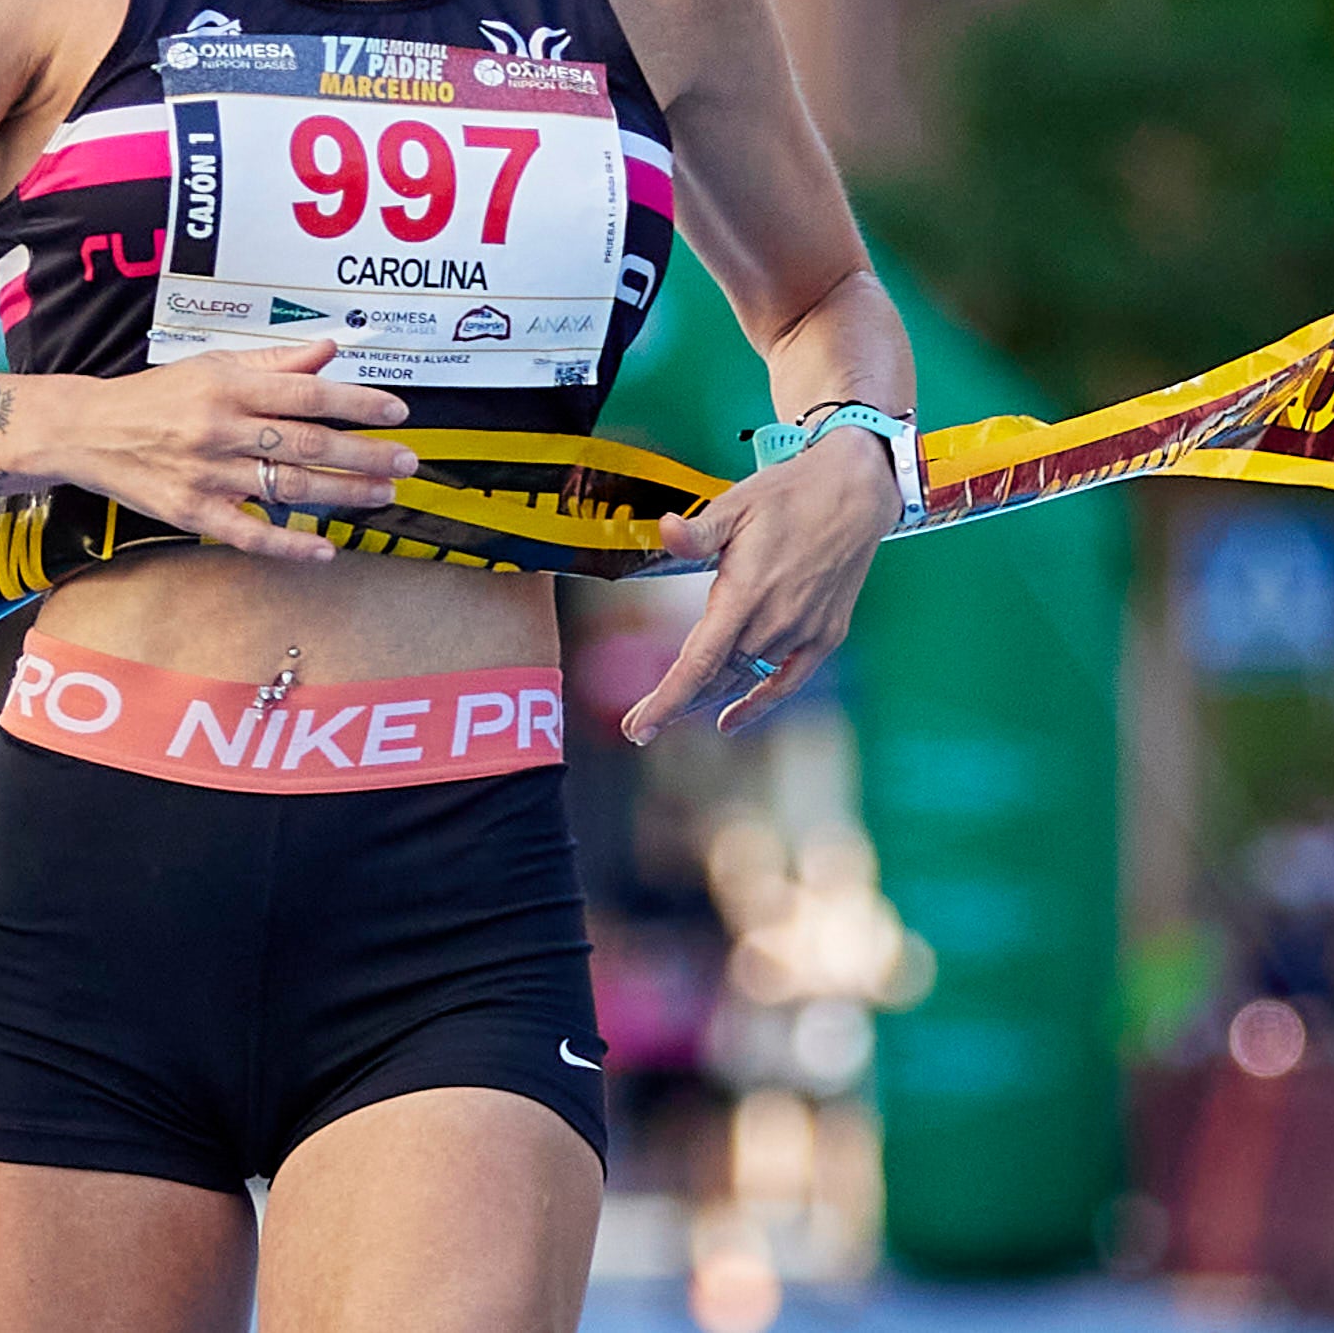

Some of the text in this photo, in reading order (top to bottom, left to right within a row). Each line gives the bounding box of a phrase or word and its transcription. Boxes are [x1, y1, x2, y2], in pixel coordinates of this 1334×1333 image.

[200, 42, 295, 58] OXIMESA
[320, 35, 448, 74] 17 MEMORIAL
[201, 59, 298, 72] NIPPON GASES
[367, 53, 444, 82] PADRE
[505, 60, 597, 84] OXIMESA
[319, 72, 455, 103] MARCELINO
[508, 78, 556, 91] NIPPON
[184, 132, 217, 239] CAJÓN 1
[289, 114, 541, 245] 997
[604, 221, 616, 263] PRUEBA
[337, 254, 489, 291] CAROLINA
[172, 295, 251, 314] CALERO
[370, 310, 437, 324] OXIMESA
[526, 316, 594, 334] ANAYA
[369, 352, 421, 363] HUERTAS
[424, 354, 471, 364] ALVAREZ
[358, 365, 414, 379] SENIOR
[166, 698, 431, 770] NIKE
